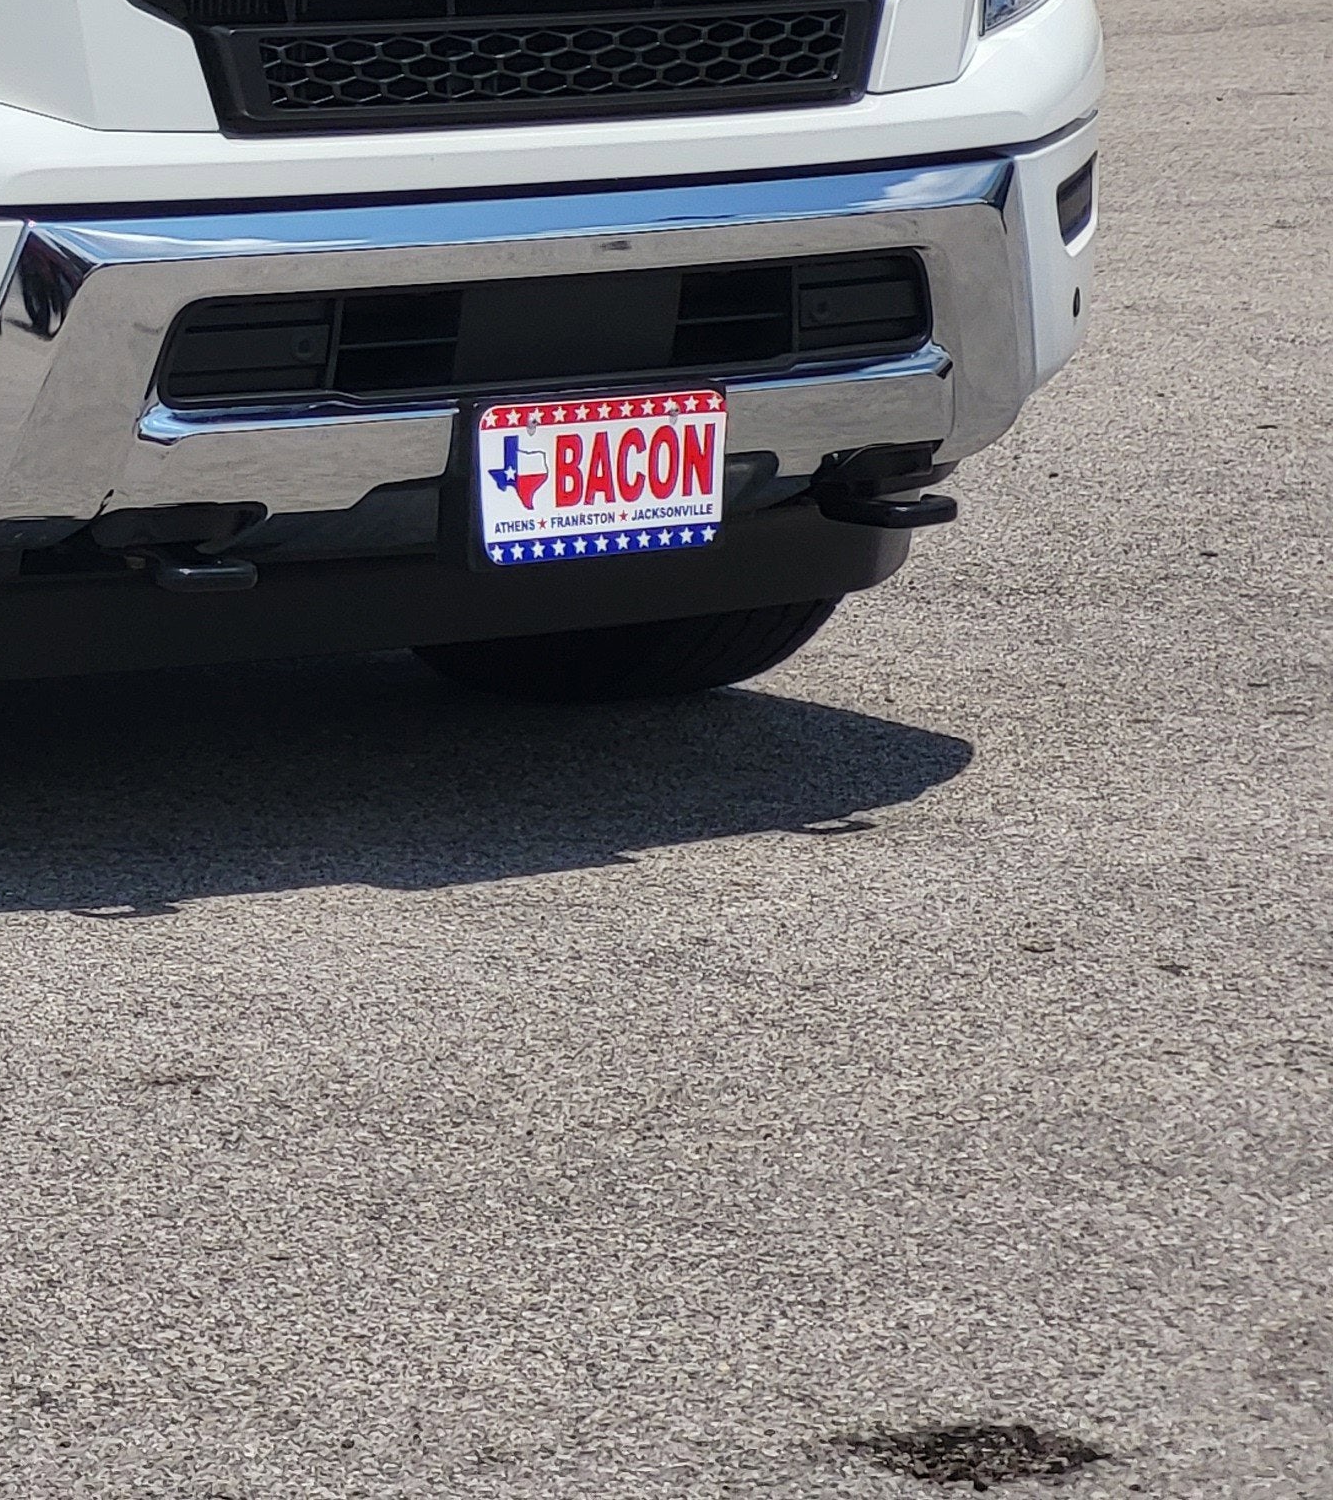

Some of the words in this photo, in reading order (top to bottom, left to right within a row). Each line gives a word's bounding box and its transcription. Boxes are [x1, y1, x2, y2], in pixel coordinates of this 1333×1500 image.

[556, 423, 716, 507] BACON
[495, 518, 536, 534] ATHENS
[632, 503, 714, 522] JACKSONVILLE
